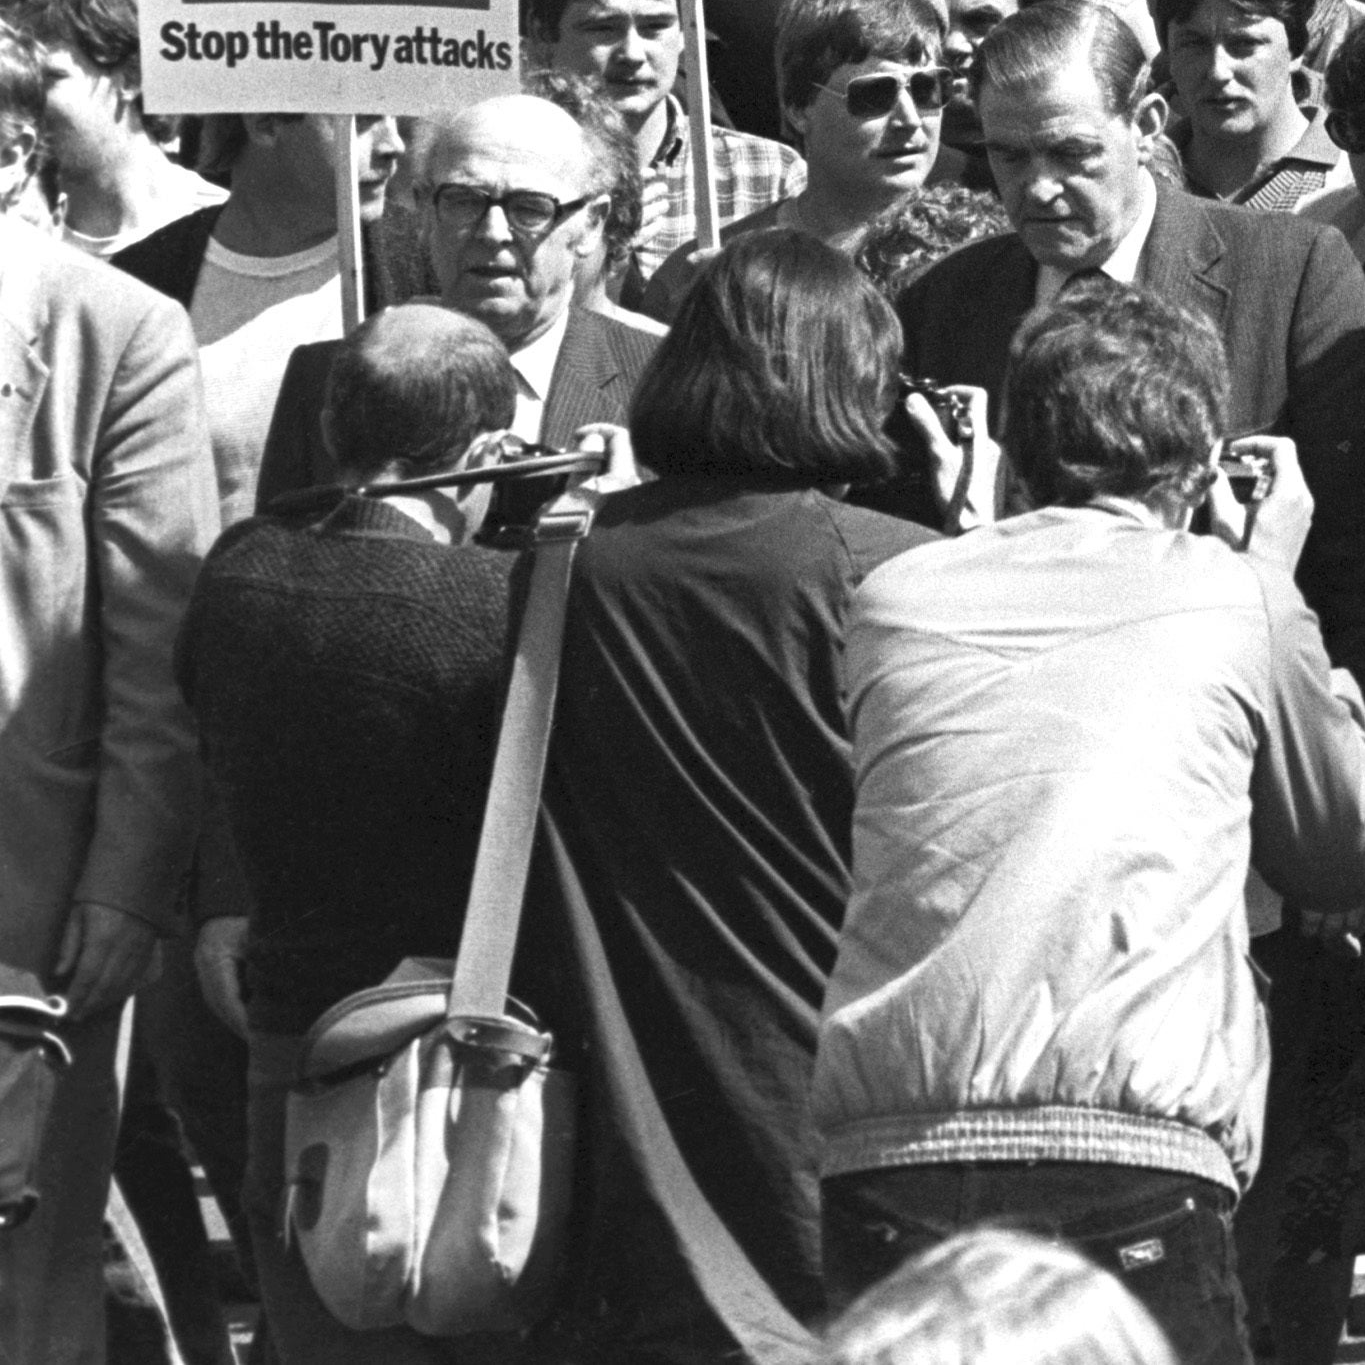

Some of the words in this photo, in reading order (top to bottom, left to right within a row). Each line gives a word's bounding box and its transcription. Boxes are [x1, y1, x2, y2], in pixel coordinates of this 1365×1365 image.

[160, 21, 249, 68] Stop
[253, 20, 313, 60] the
[314, 21, 390, 71] Tory
[394, 28, 512, 70] attacks
